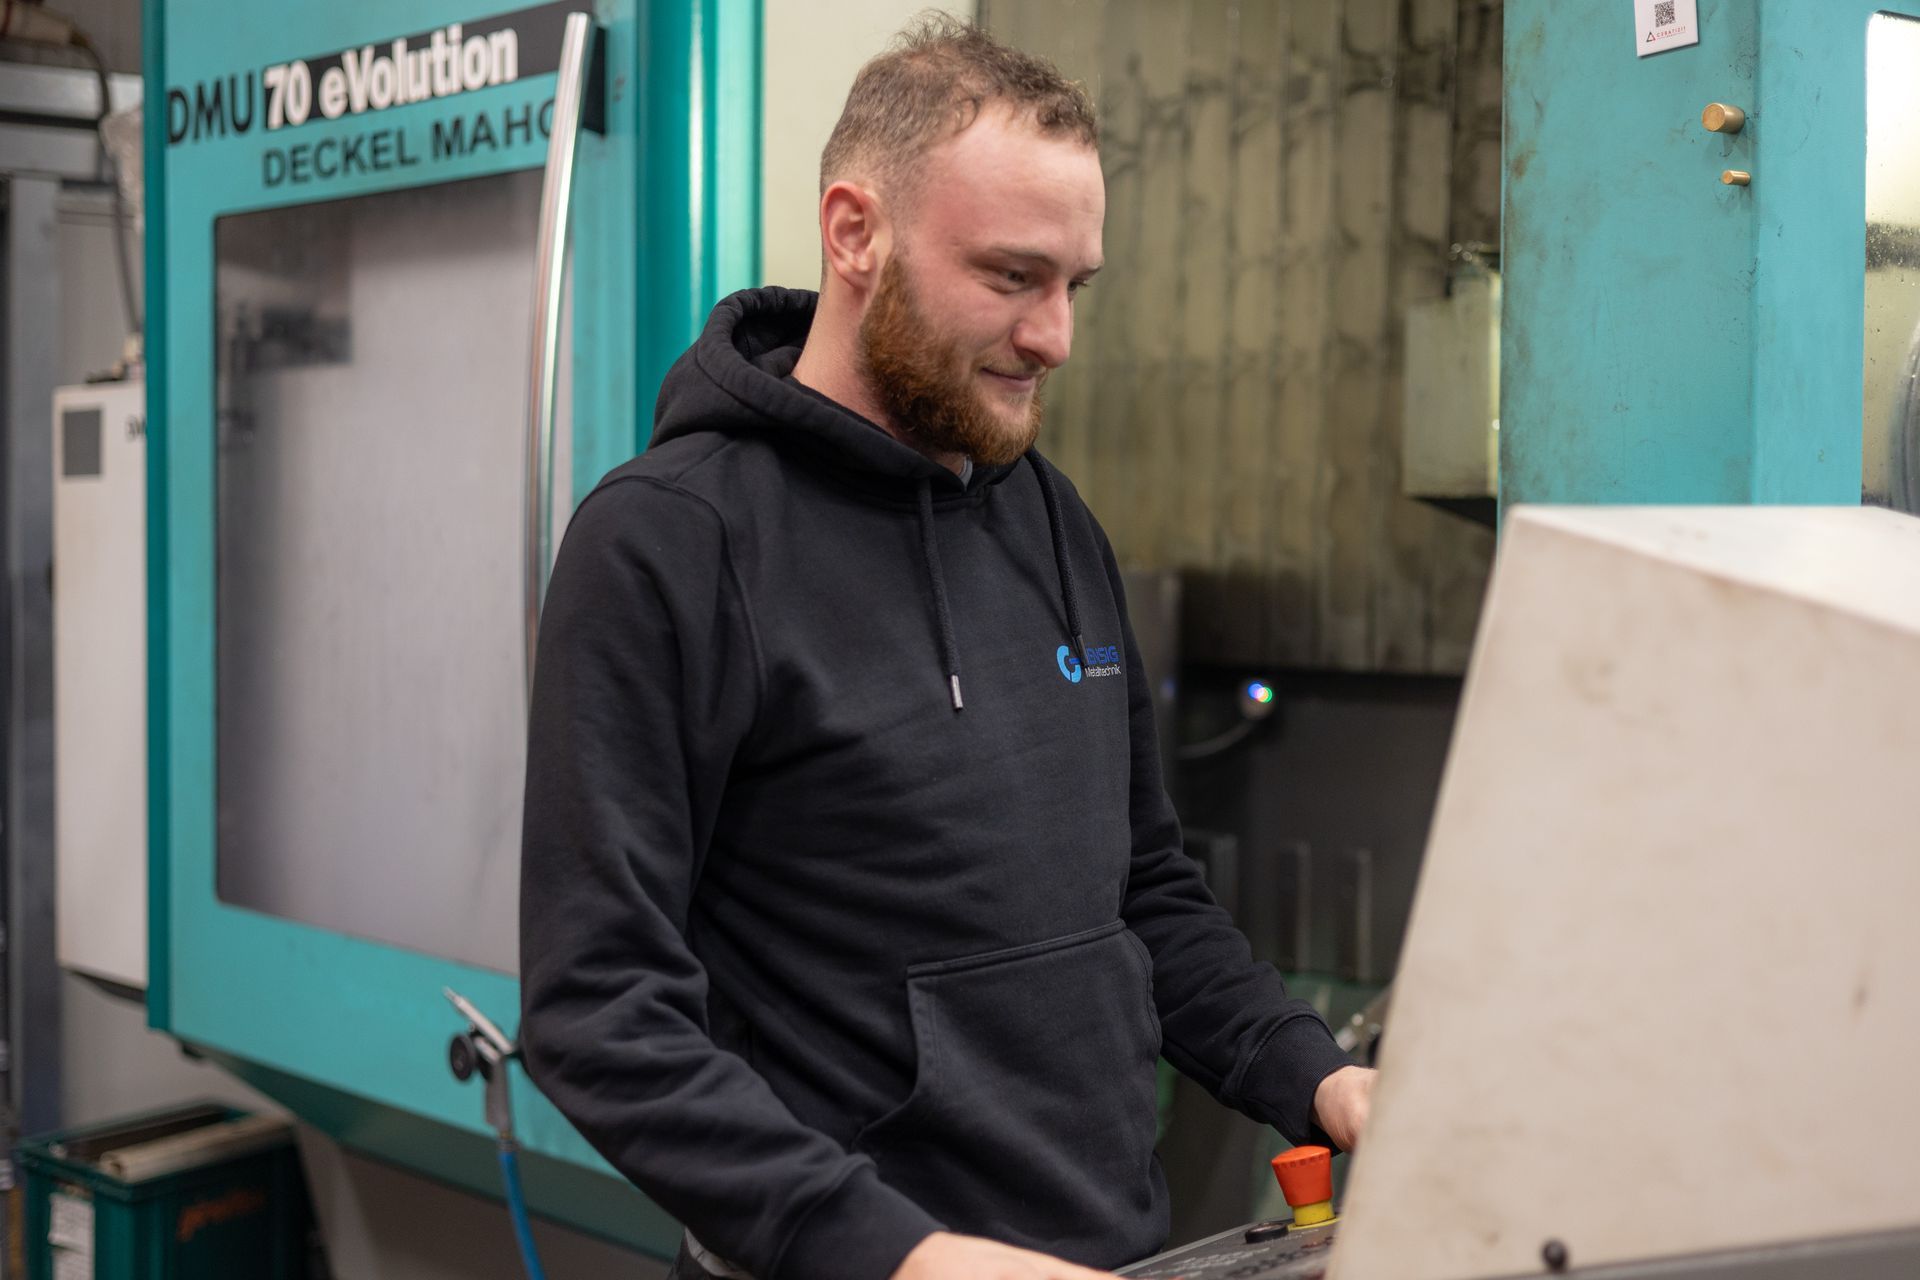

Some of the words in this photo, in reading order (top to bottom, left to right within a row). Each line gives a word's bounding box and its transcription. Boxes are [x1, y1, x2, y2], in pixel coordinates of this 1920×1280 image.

[168, 71, 256, 146] DMU
[264, 60, 313, 129] 70
[319, 23, 519, 120] eVolution
[263, 129, 418, 188] DECKEL
